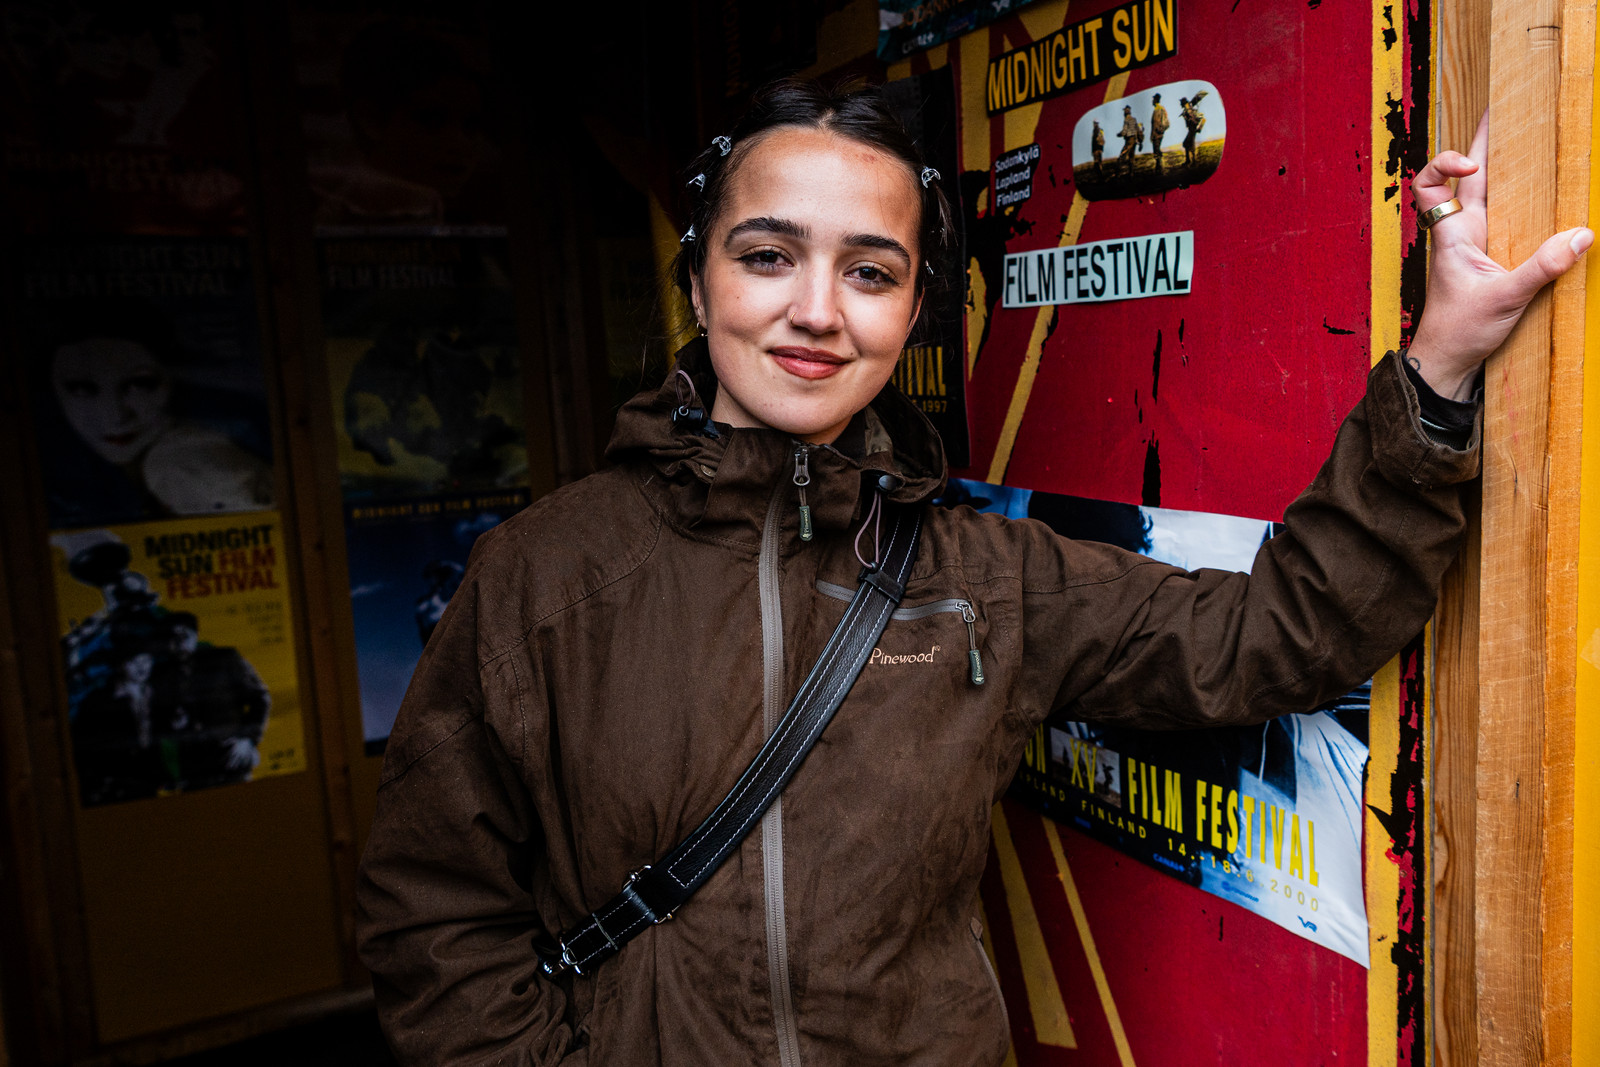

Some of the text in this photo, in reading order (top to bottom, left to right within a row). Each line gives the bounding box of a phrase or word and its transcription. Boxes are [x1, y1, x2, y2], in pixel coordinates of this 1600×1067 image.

[988, 0, 1175, 112] MIDNIGHT SUN
[994, 146, 1040, 173] Sodankylä
[994, 166, 1031, 190] Lapland
[995, 185, 1031, 208] Finland
[24, 271, 229, 298] FILM FESTIVAL
[327, 263, 457, 288] FILM FESTIVAL
[1005, 236, 1189, 304] FILM FESTIVAL
[145, 525, 272, 557] MIDNIGHT
[158, 547, 276, 579] SUN FILM
[166, 570, 279, 599] FESTIVAL
[1069, 737, 1098, 794] XV
[1127, 757, 1184, 834] FILM
[1196, 779, 1319, 888] FESTIVAL
[1081, 799, 1148, 839] FINLAND
